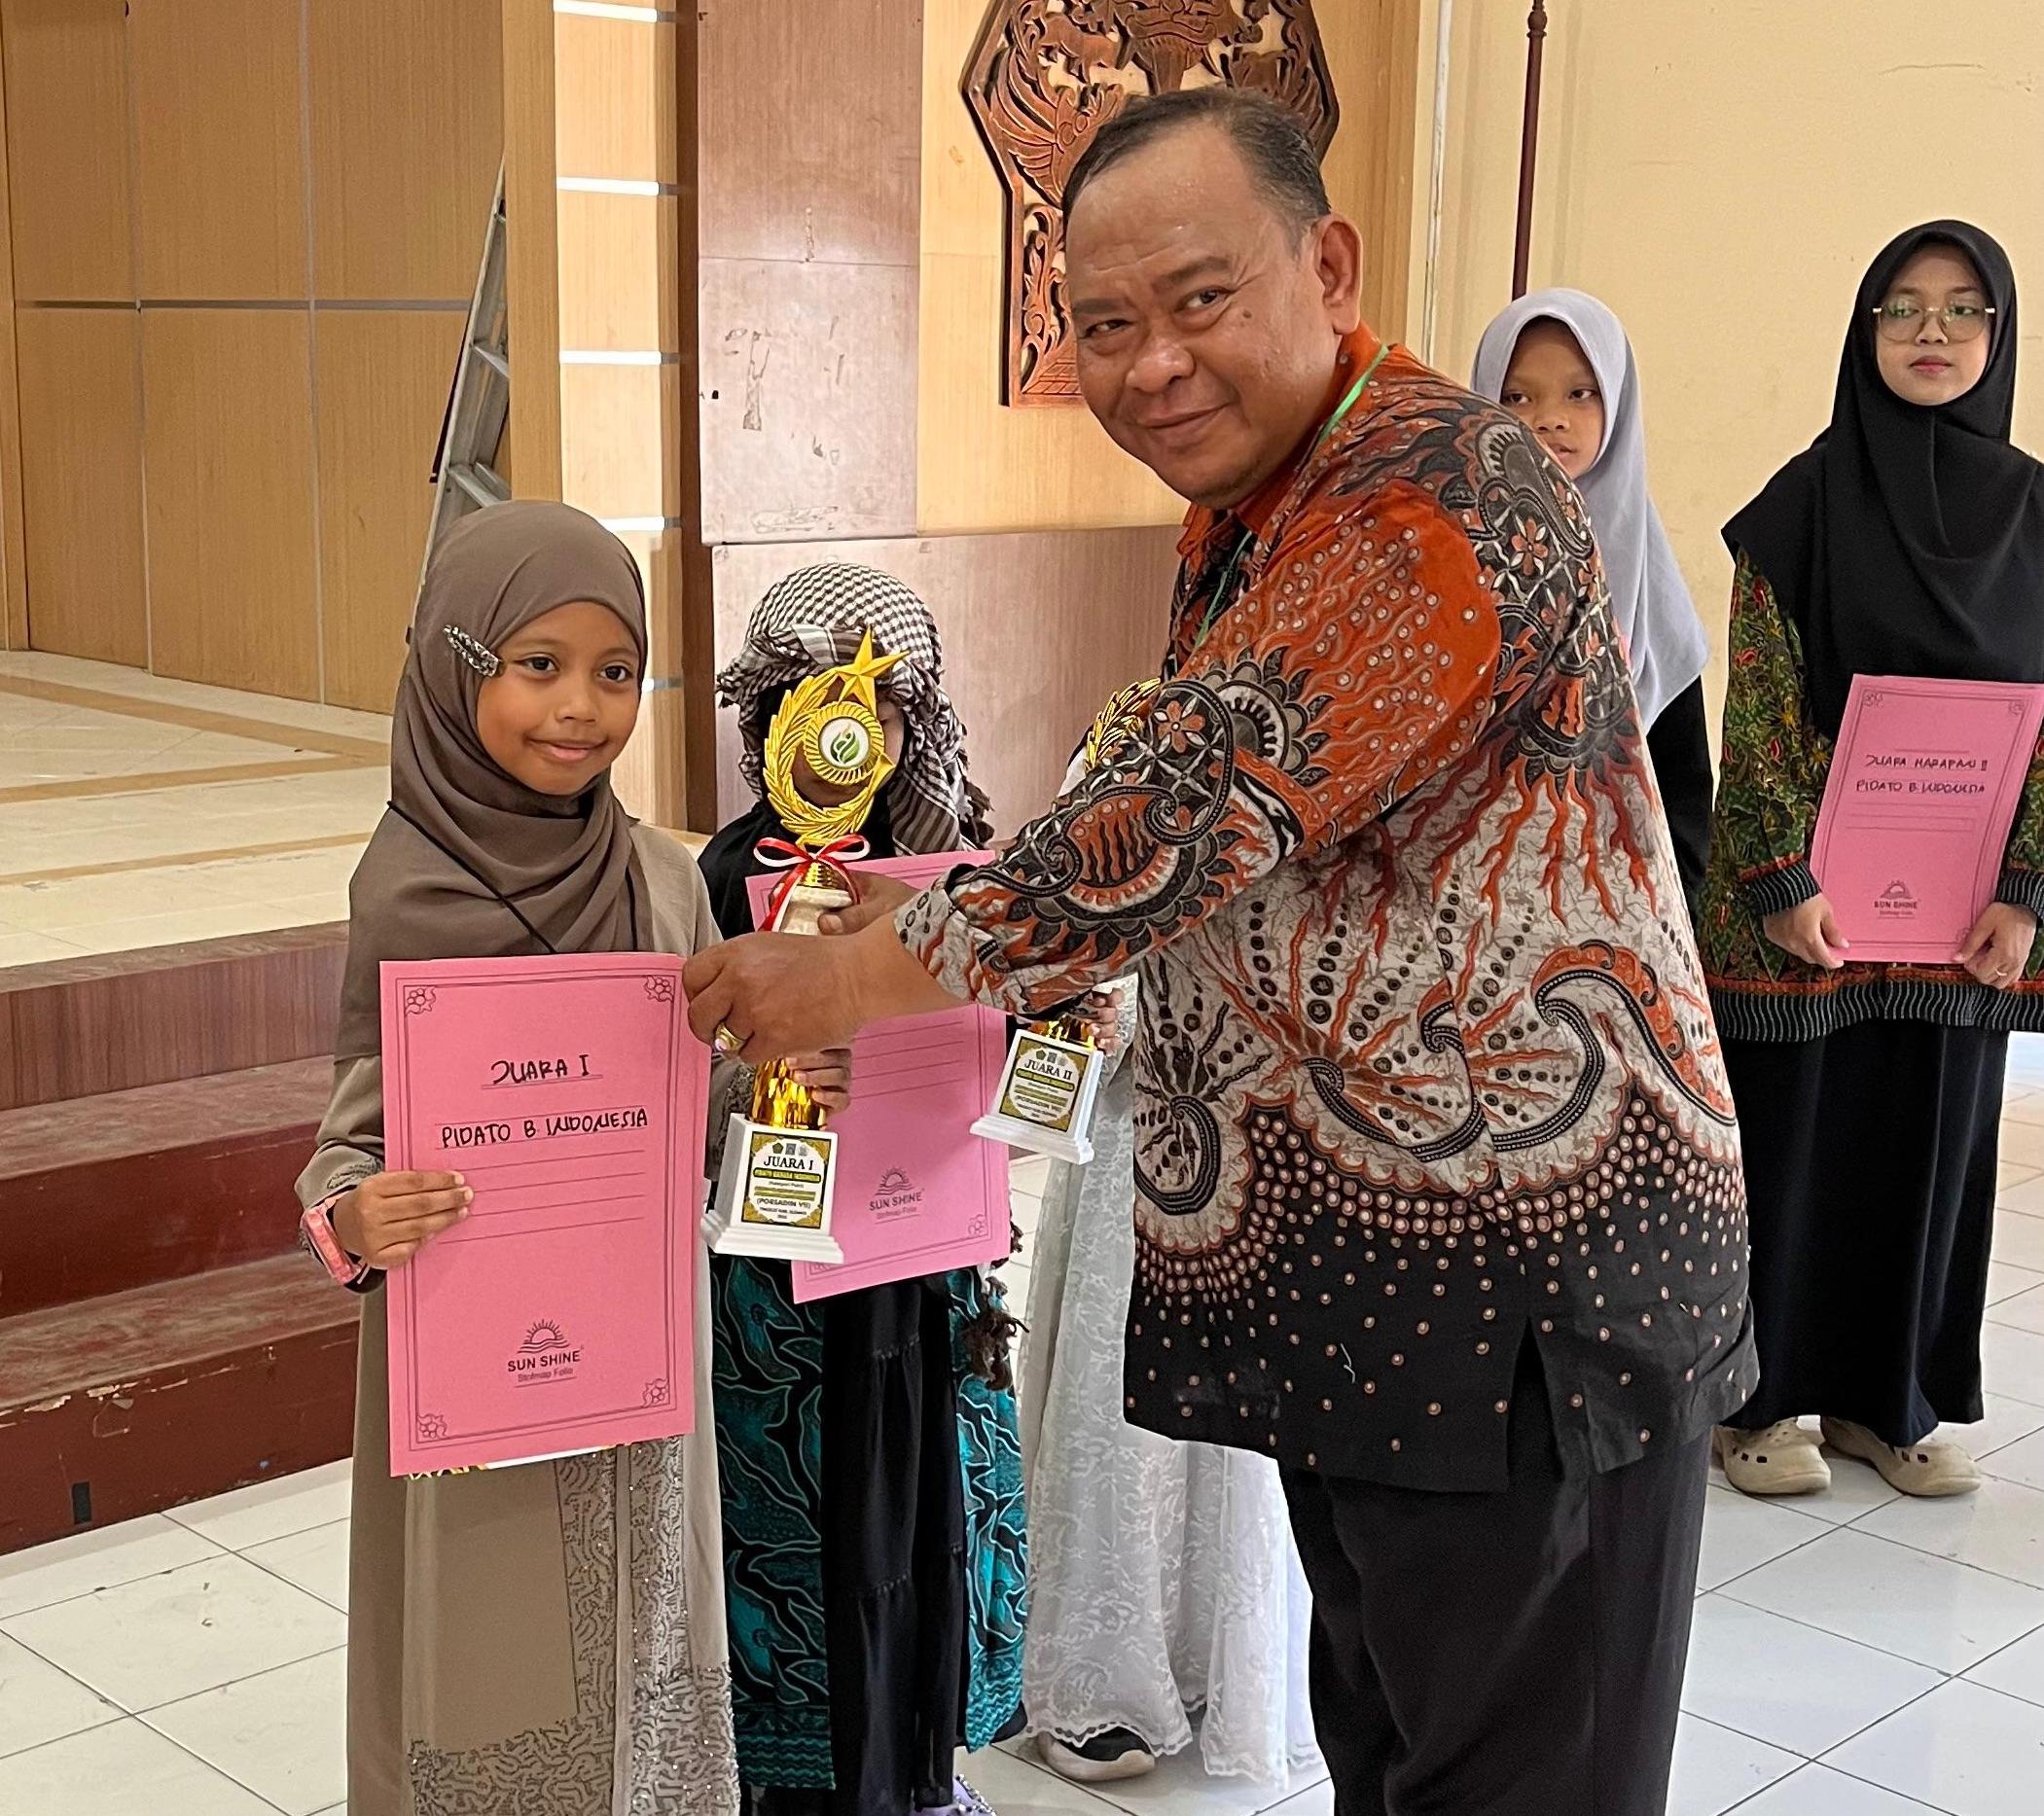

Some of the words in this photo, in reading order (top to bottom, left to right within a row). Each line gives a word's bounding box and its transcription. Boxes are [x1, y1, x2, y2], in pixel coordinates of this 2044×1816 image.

[1856, 779, 1903, 793] PIDATO
[490, 1058, 568, 1085] JUARA
[579, 1053, 590, 1077] I
[1024, 1059, 1059, 1077] JUARA
[442, 1123, 511, 1149] PIDATO
[546, 1108, 648, 1136] INDONESIA
[763, 1156, 806, 1170] JUARA
[808, 1159, 814, 1171] I
[869, 1198, 890, 1212] SUN
[507, 1357, 536, 1372] SUN
[539, 1349, 581, 1368] SHINE
